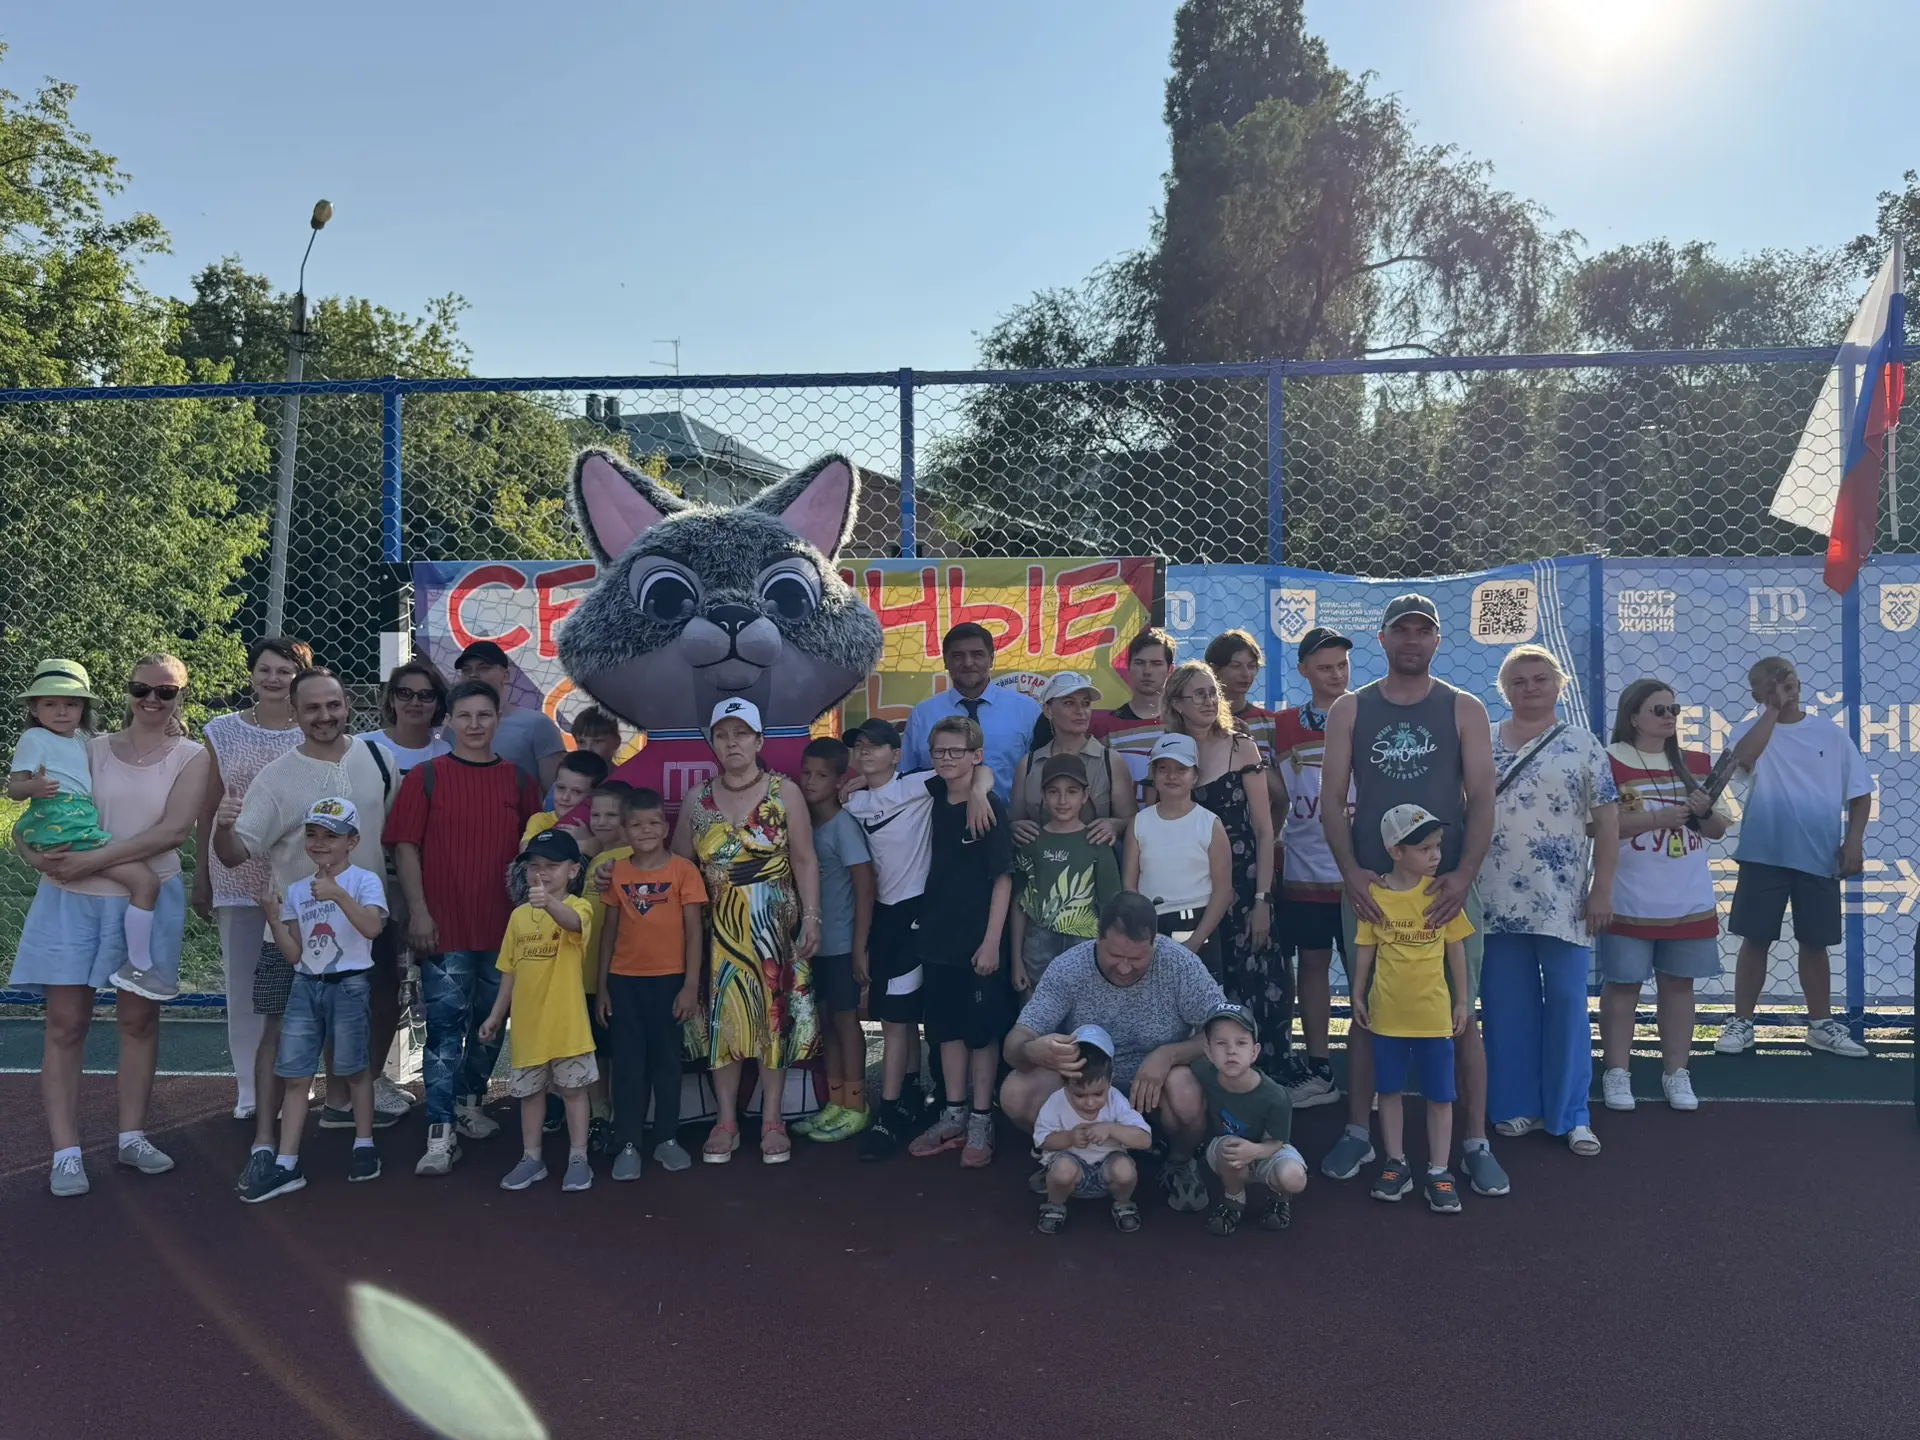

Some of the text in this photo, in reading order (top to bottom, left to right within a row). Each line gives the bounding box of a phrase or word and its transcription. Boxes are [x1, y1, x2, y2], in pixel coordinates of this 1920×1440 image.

[1618, 590, 1665, 604] СПОРТ
[1618, 604, 1675, 618] НОРМА
[1617, 618, 1675, 632] ЖИЗНИ
[1020, 674, 1045, 687] СТАР
[1370, 737, 1438, 764] Surfside
